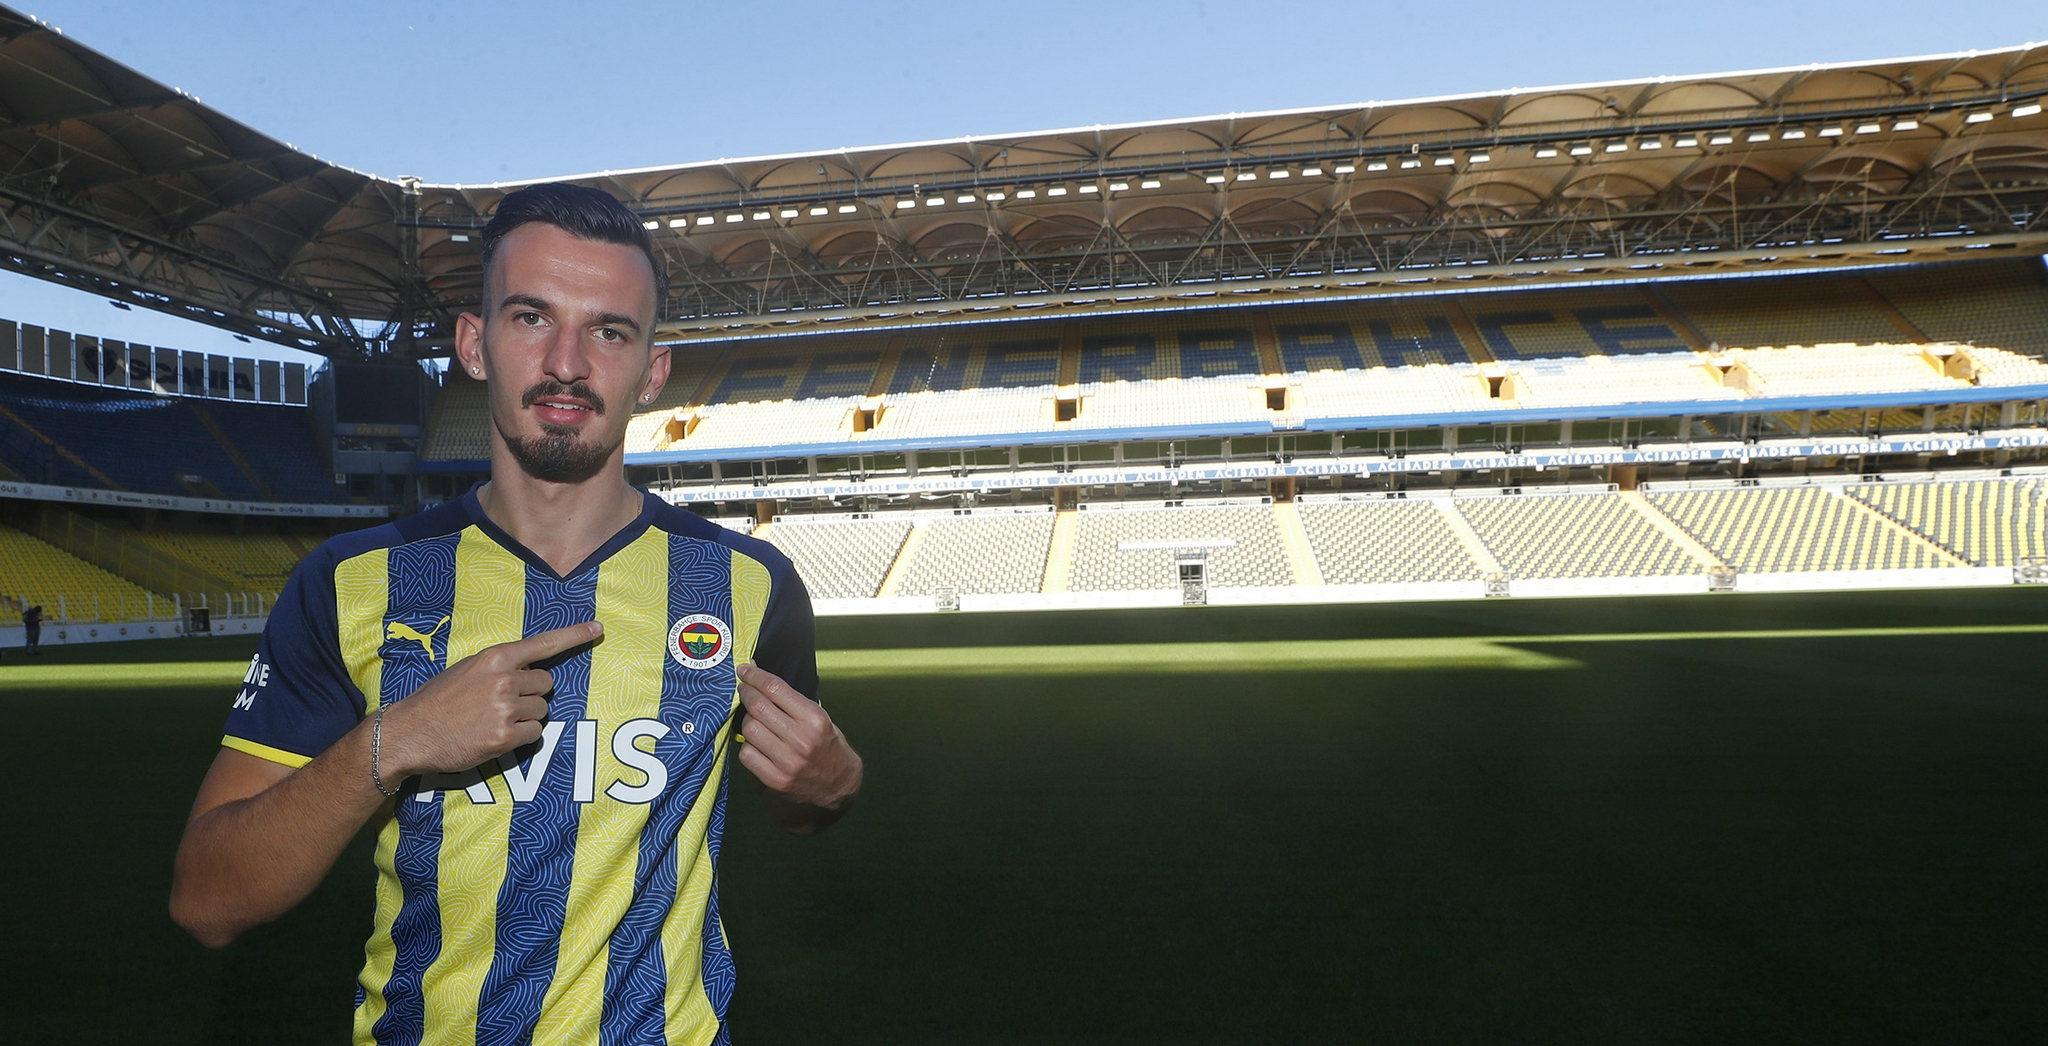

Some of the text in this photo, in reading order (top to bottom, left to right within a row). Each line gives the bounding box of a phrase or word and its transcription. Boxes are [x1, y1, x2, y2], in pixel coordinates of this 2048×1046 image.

[124, 357, 254, 394] SCANIA
[1136, 470, 1206, 481] ACIBADEM
[1216, 467, 1286, 478] ACIBADEM
[1296, 464, 1367, 475] ACIBADEM
[1378, 460, 1451, 471] ACIBADEM
[1463, 457, 1537, 468] ACIBADEM
[1547, 454, 1624, 465] ACIBADEM
[1633, 450, 1712, 462] ACIBADEM
[1721, 446, 1801, 459] ACIBADEM
[1811, 443, 1892, 455] ACIBADEM
[1901, 438, 1986, 452] ACIBADEM
[1997, 435, 2048, 448] ACIBA
[670, 615, 698, 656] FENERBAHÇE
[701, 616, 723, 628] SPOR
[689, 660, 708, 668] 1907
